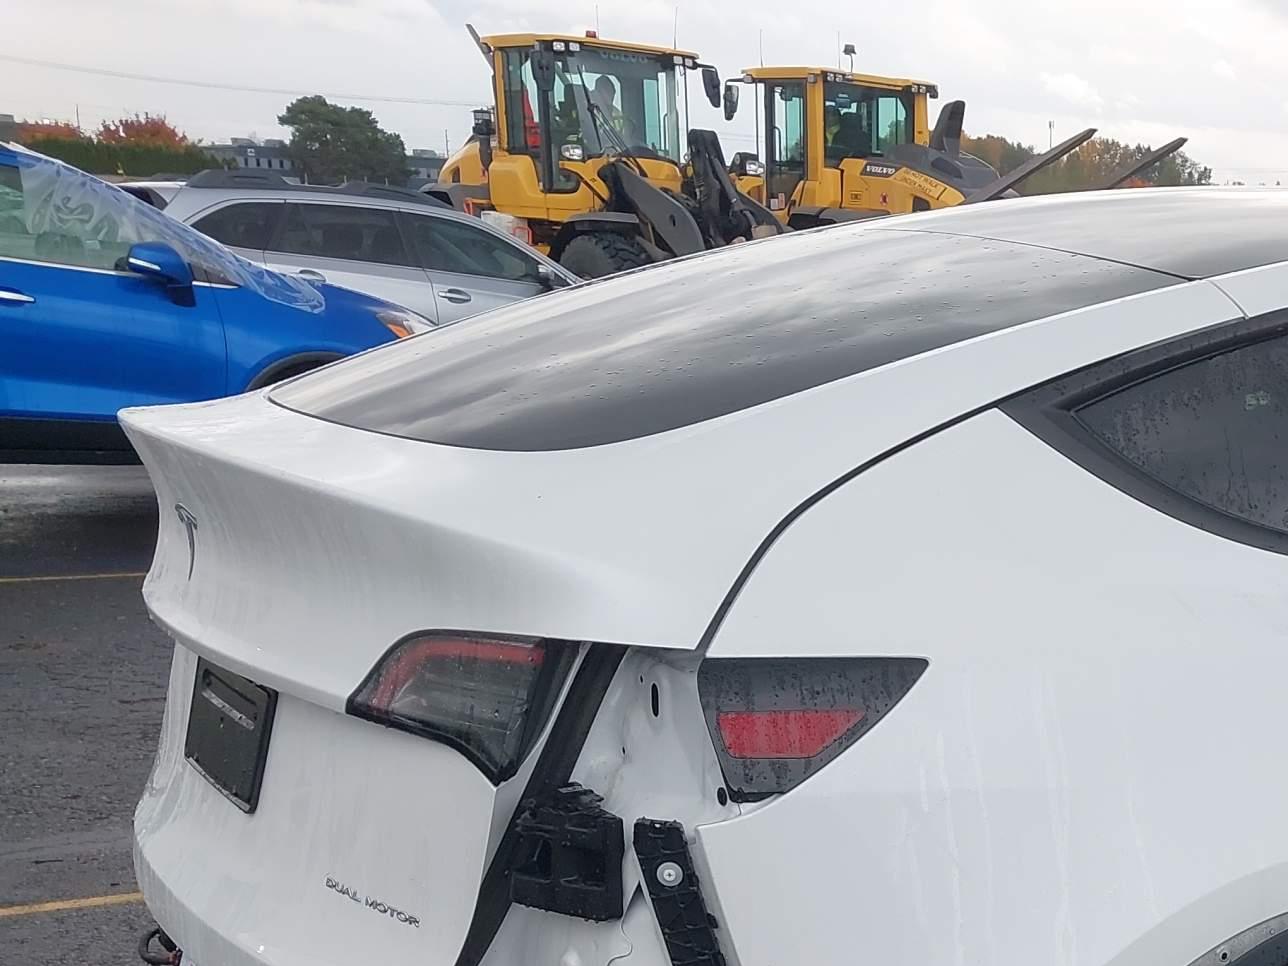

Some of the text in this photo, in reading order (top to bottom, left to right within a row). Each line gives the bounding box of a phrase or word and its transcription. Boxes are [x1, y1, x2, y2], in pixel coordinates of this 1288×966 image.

[866, 165, 896, 175] VOLVO
[325, 877, 420, 928] DUAL MOTOR
